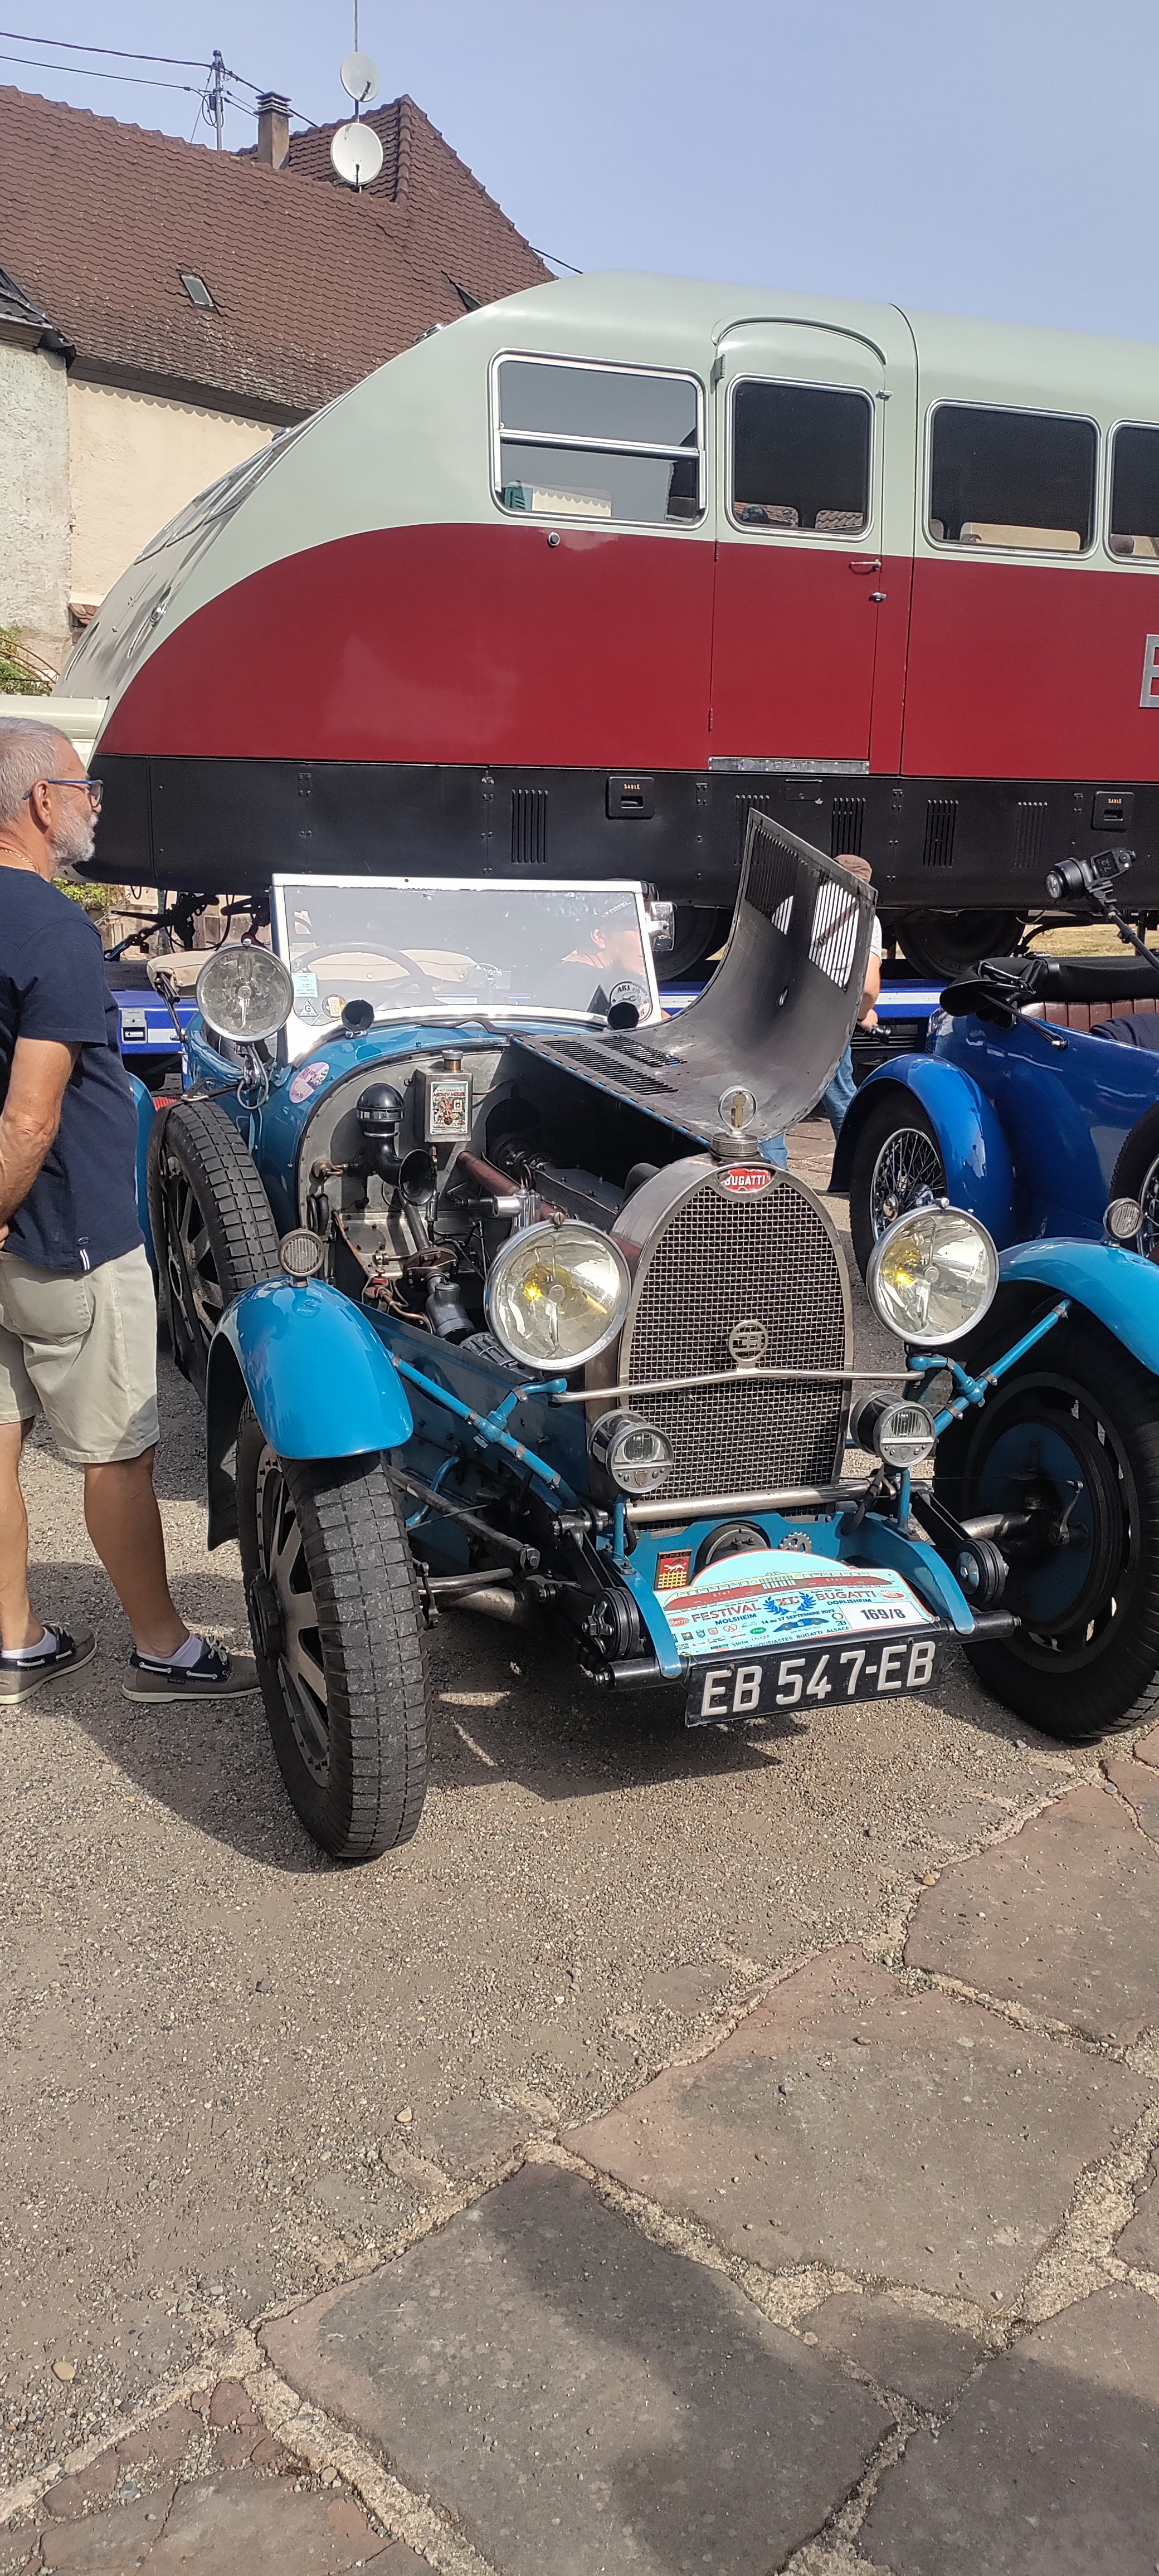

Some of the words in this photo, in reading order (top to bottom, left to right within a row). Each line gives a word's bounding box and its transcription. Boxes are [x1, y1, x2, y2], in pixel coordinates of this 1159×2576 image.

[724, 1174, 766, 1186] BUGATTI
[815, 1591, 877, 1601] BUGATTI
[691, 1603, 762, 1623] FESTIVAL
[786, 1611, 821, 1620] SEPTEMBRE
[860, 1608, 906, 1621] 169/8
[715, 1613, 757, 1626] MOLSHEIM
[796, 1630, 823, 1639] BUGATTI
[701, 1665, 762, 1717] EB
[776, 1641, 936, 1705] 547-EB
